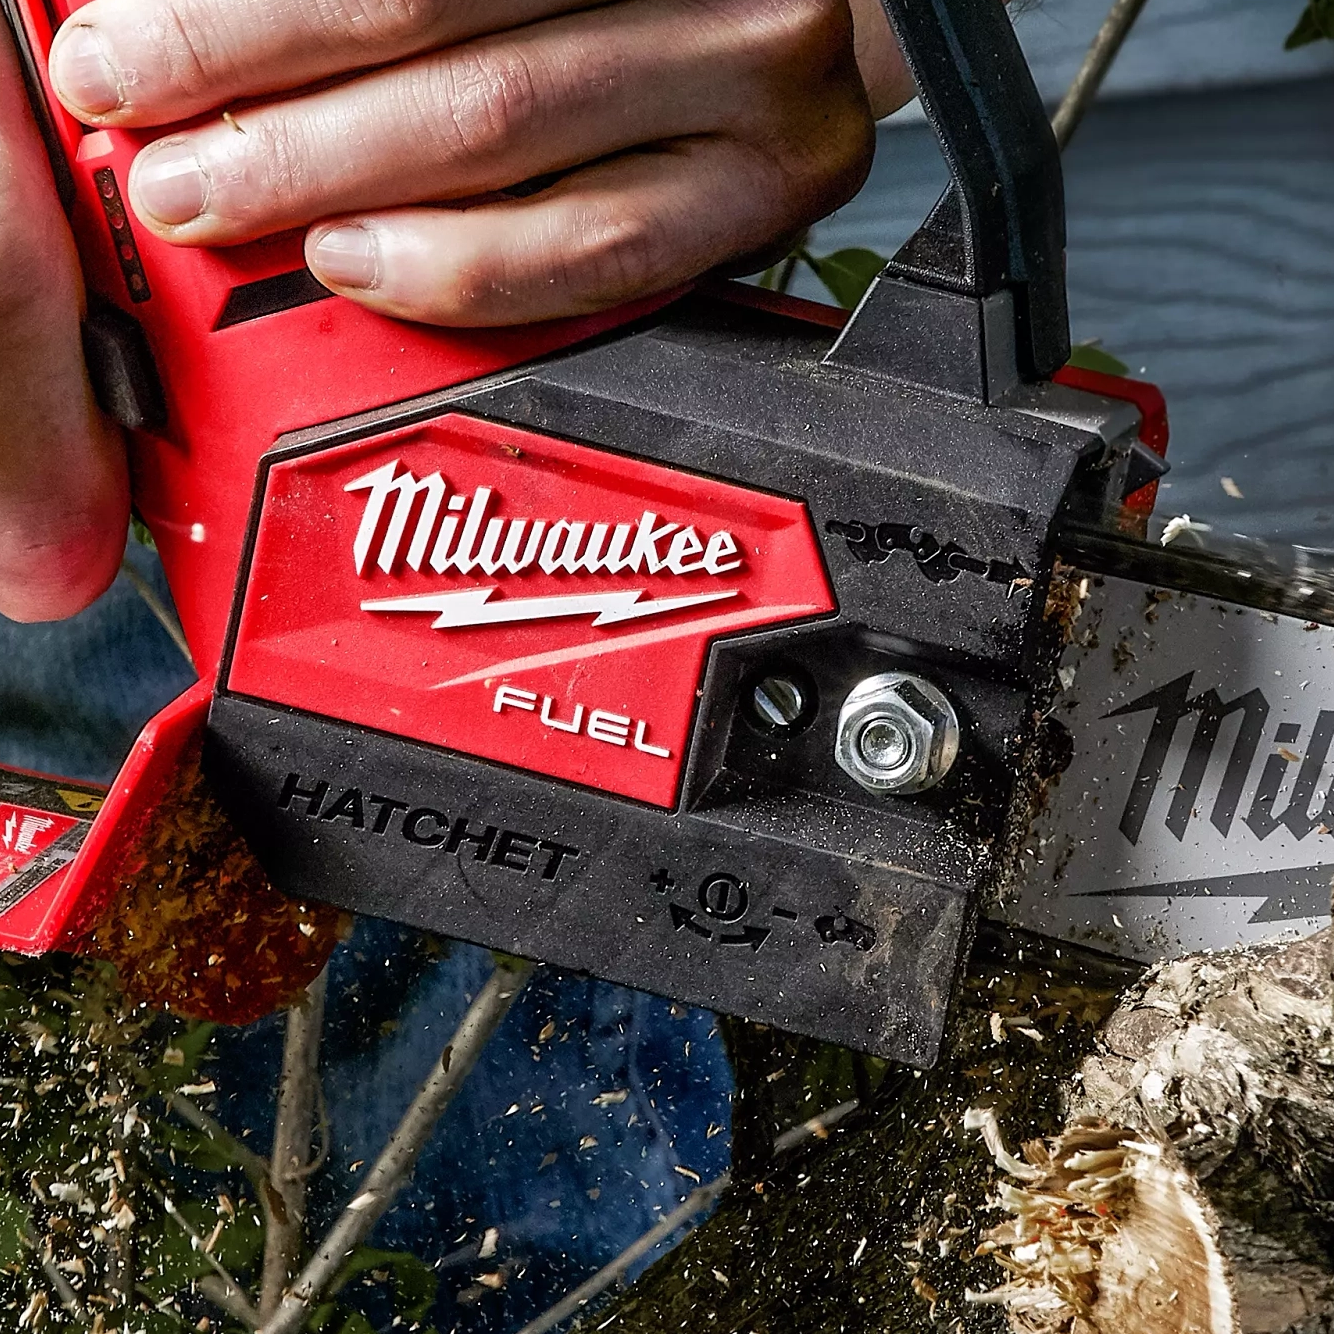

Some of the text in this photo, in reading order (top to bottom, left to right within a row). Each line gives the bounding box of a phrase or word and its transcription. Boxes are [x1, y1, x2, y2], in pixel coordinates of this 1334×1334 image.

[343, 459, 743, 576] Milwaukee
[492, 683, 672, 760] FUEL
[276, 771, 580, 883] HATCHET
